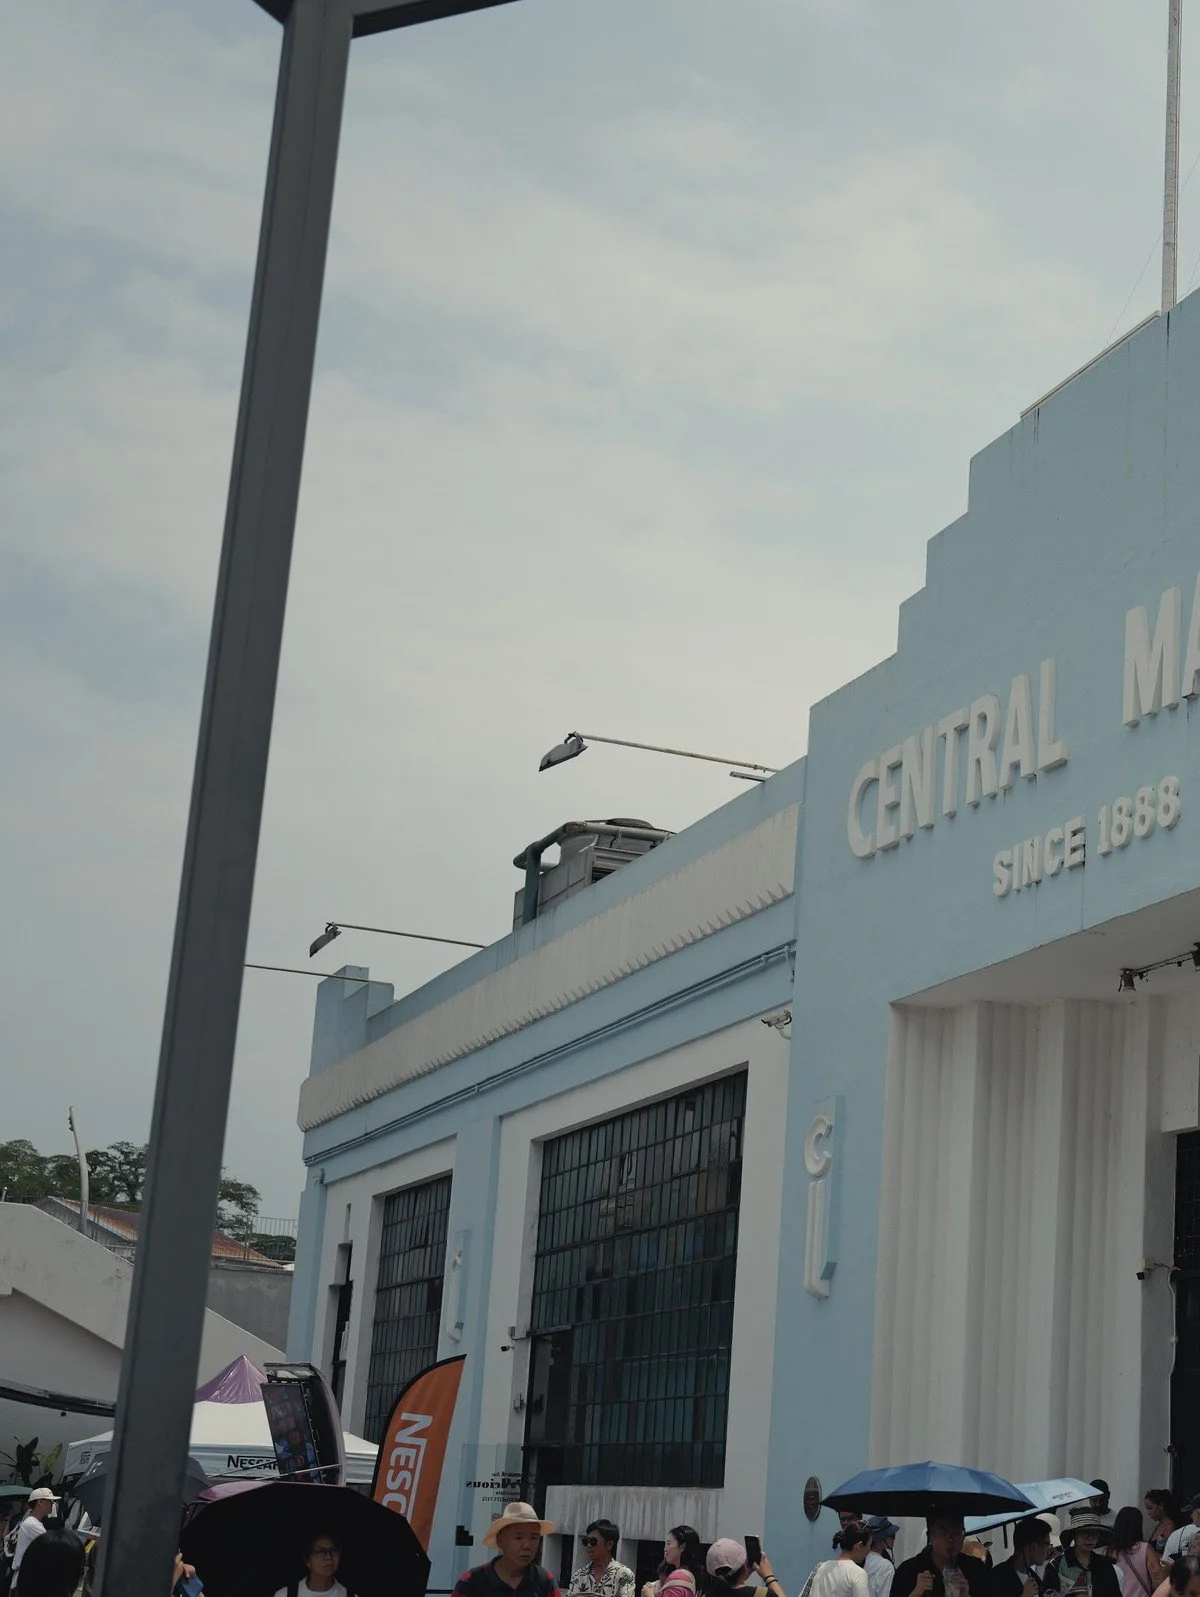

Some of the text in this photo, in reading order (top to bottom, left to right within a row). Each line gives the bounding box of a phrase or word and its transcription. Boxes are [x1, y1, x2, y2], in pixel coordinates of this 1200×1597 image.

[847, 658, 1070, 859] CENTRAL
[991, 774, 1182, 898] SINCE 1888
